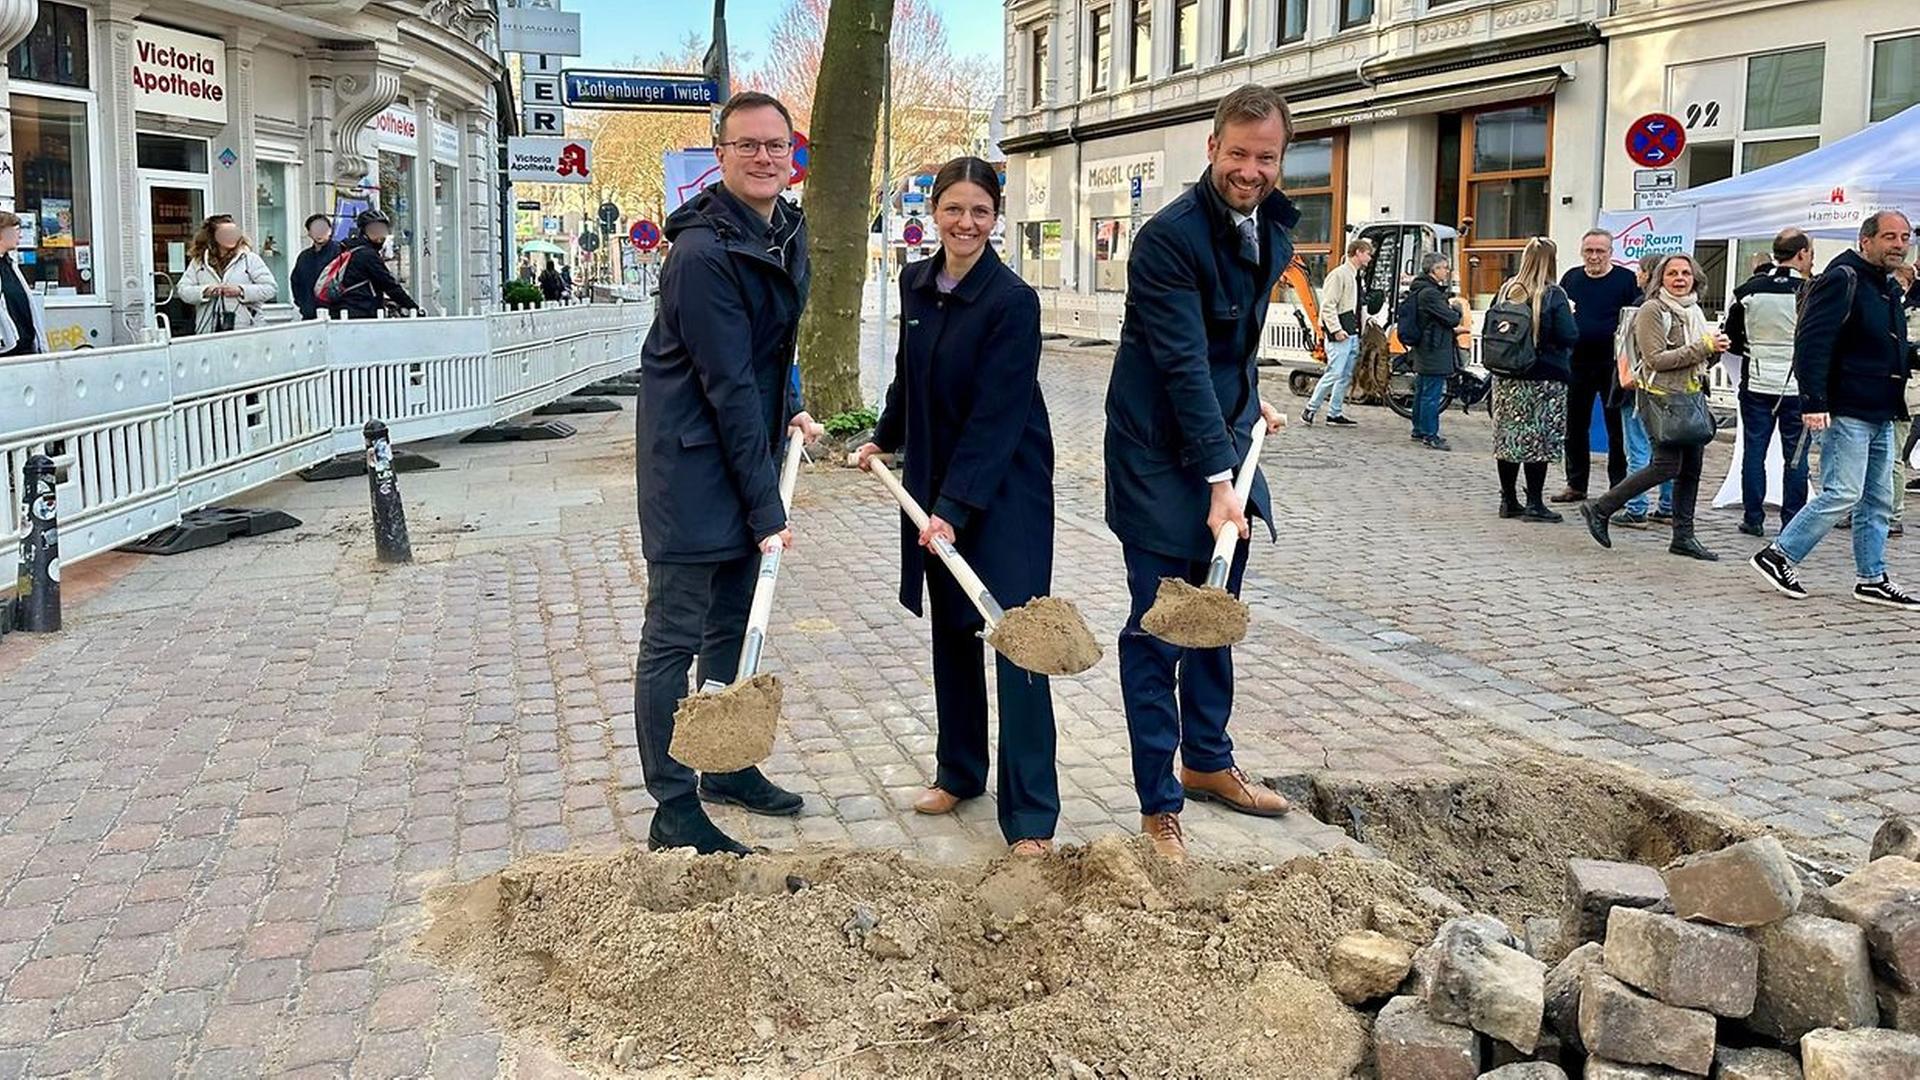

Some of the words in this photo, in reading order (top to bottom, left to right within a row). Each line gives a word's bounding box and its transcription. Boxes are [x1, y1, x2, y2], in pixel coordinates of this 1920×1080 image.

[136, 39, 214, 75] Victoria
[133, 66, 223, 102] Apotheke
[576, 79, 665, 102] Mottenburger
[672, 83, 712, 101] Twiete
[376, 112, 416, 138] otheke
[1686, 101, 1720, 129] 92
[511, 163, 555, 172] Apotheke
[514, 154, 551, 164] Victoria
[1088, 165, 1123, 187] MASAL
[1808, 210, 1860, 221] Hamburg
[1623, 234, 1683, 248] freiRaum
